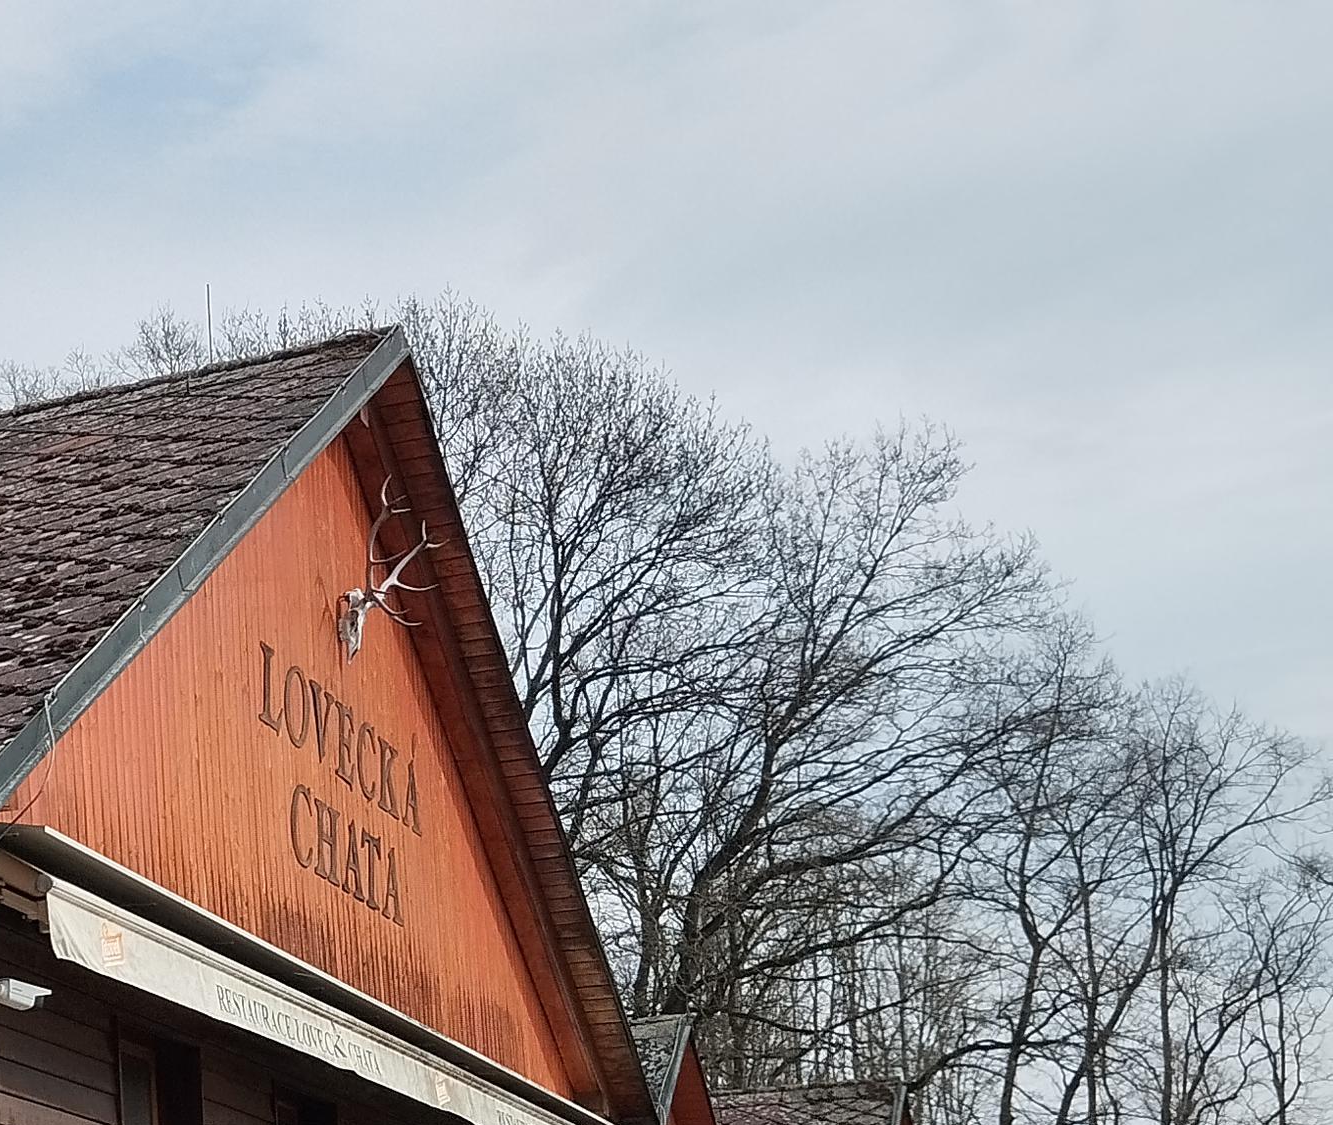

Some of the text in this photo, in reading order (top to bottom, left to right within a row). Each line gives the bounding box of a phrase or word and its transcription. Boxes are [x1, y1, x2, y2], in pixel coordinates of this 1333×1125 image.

[258, 640, 422, 837] LOVECKÁ
[290, 784, 404, 927] CHATA
[216, 984, 296, 1041] RESTAURACE
